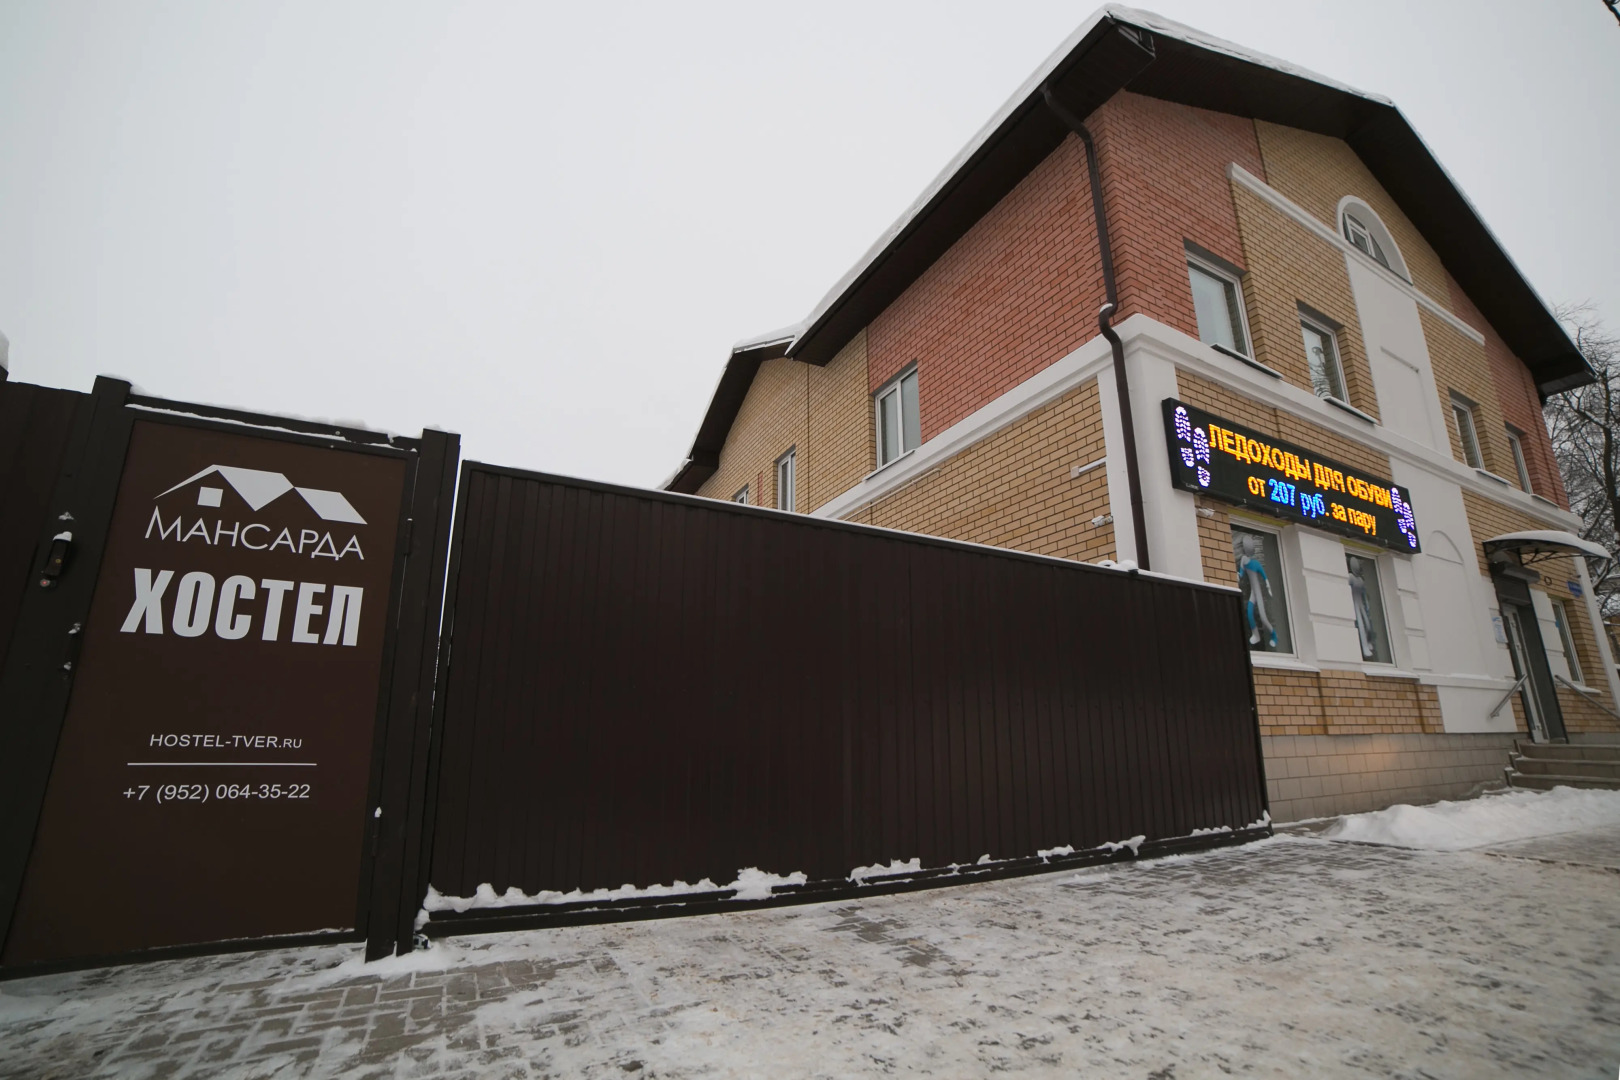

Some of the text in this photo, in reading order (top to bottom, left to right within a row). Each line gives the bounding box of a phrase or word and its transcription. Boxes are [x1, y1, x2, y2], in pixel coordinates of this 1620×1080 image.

[1208, 423, 1393, 509] ЛЕДОХОДЫ ДЛЯ ОБУВИ
[145, 505, 364, 561] МАНСАРДА
[1268, 478, 1296, 507] 207
[1299, 493, 1330, 519] руб.
[1330, 502, 1347, 522] за
[1347, 507, 1376, 536] пару
[120, 568, 364, 646] ХОСТЕЛ
[150, 734, 302, 749] HOSTEL-TVER.RU
[123, 784, 311, 804] +7 (952) 064-35-22
